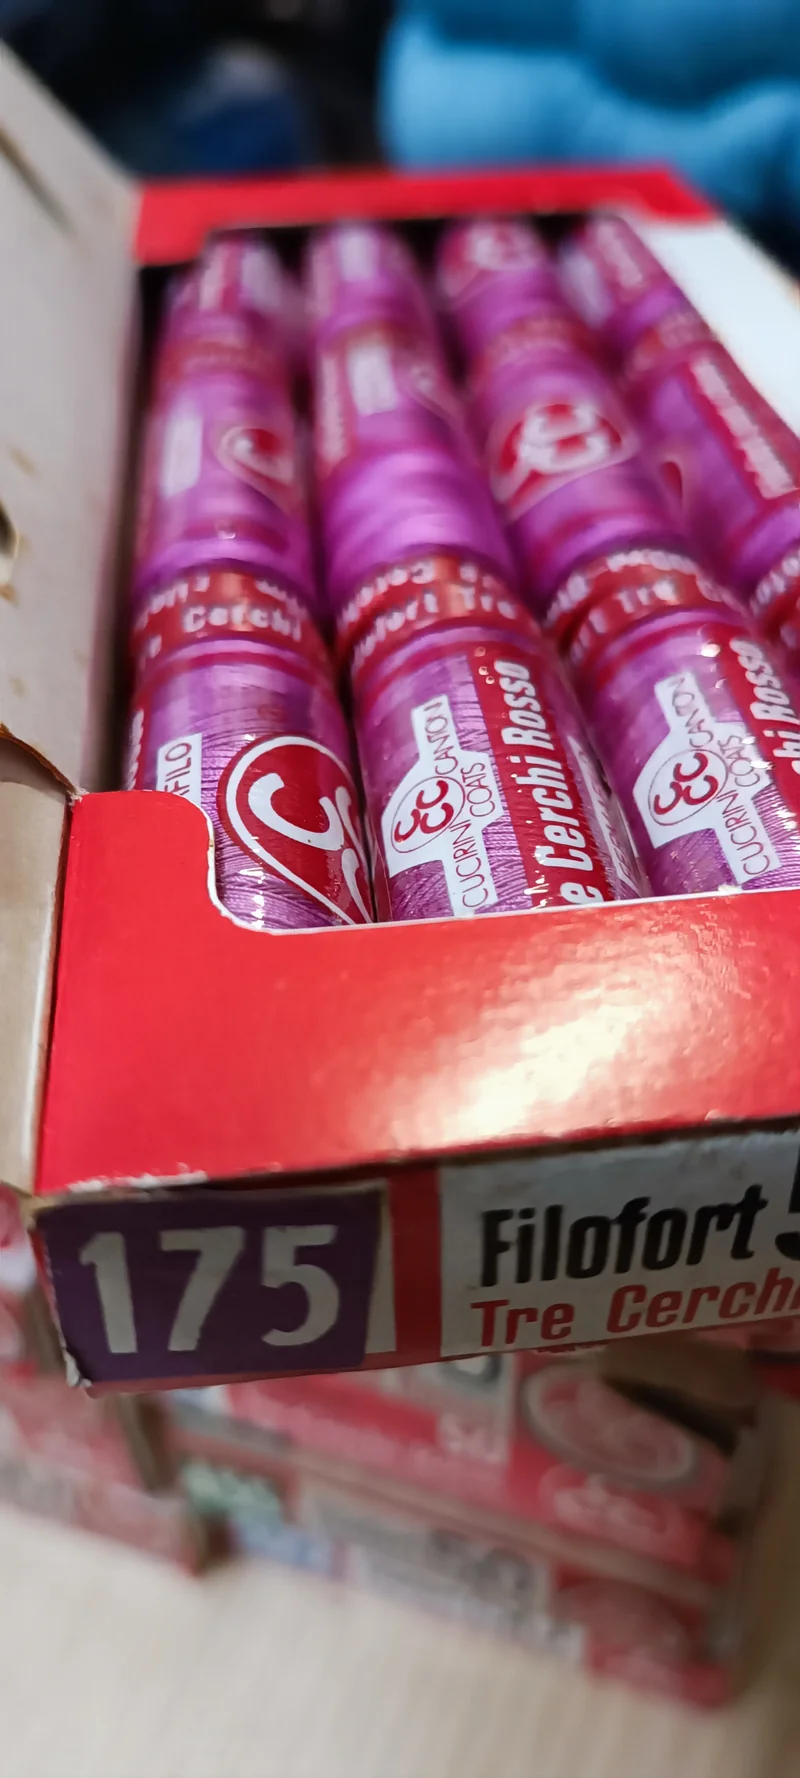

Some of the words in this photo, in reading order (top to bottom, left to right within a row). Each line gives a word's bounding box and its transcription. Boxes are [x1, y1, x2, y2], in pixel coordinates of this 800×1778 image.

[494, 659, 554, 751] Rosso
[460, 762, 496, 818] COATS
[509, 755, 594, 872] Cerchi
[715, 789, 771, 876] CUCIRINI
[449, 819, 489, 908] CUCIRINI
[480, 1184, 769, 1288] Filofort
[79, 1225, 340, 1354] 175
[470, 1299, 576, 1348] Tre
